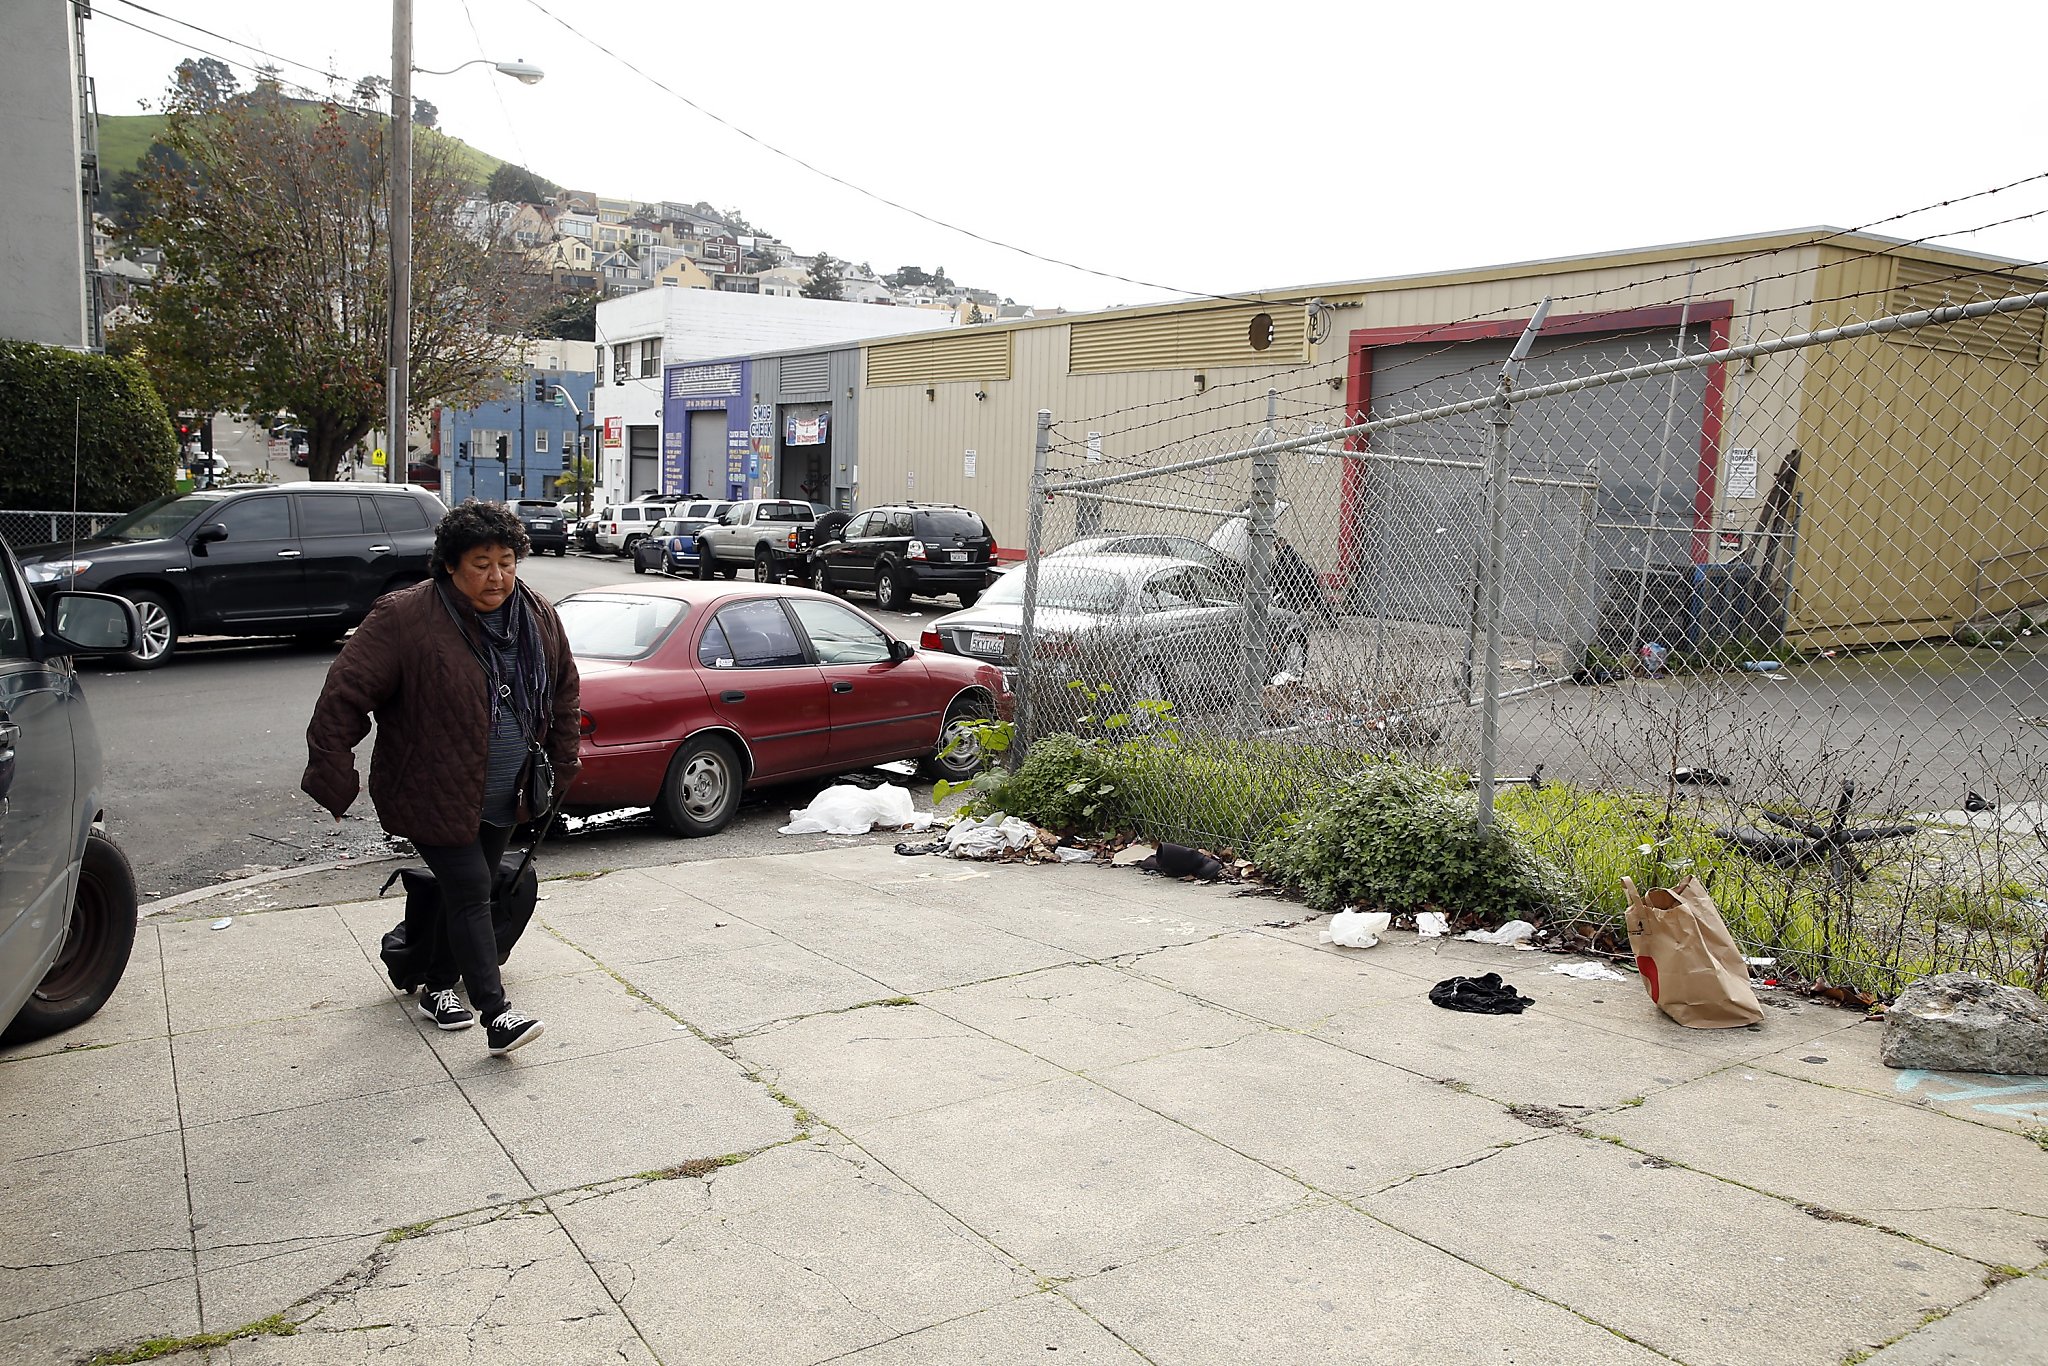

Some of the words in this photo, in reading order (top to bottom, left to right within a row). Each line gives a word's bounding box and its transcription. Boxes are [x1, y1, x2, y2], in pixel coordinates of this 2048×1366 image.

[683, 364, 731, 382] EXCELLENT
[753, 406, 772, 421] SMOG
[750, 421, 773, 438] CHECK
[759, 445, 772, 460] OIL
